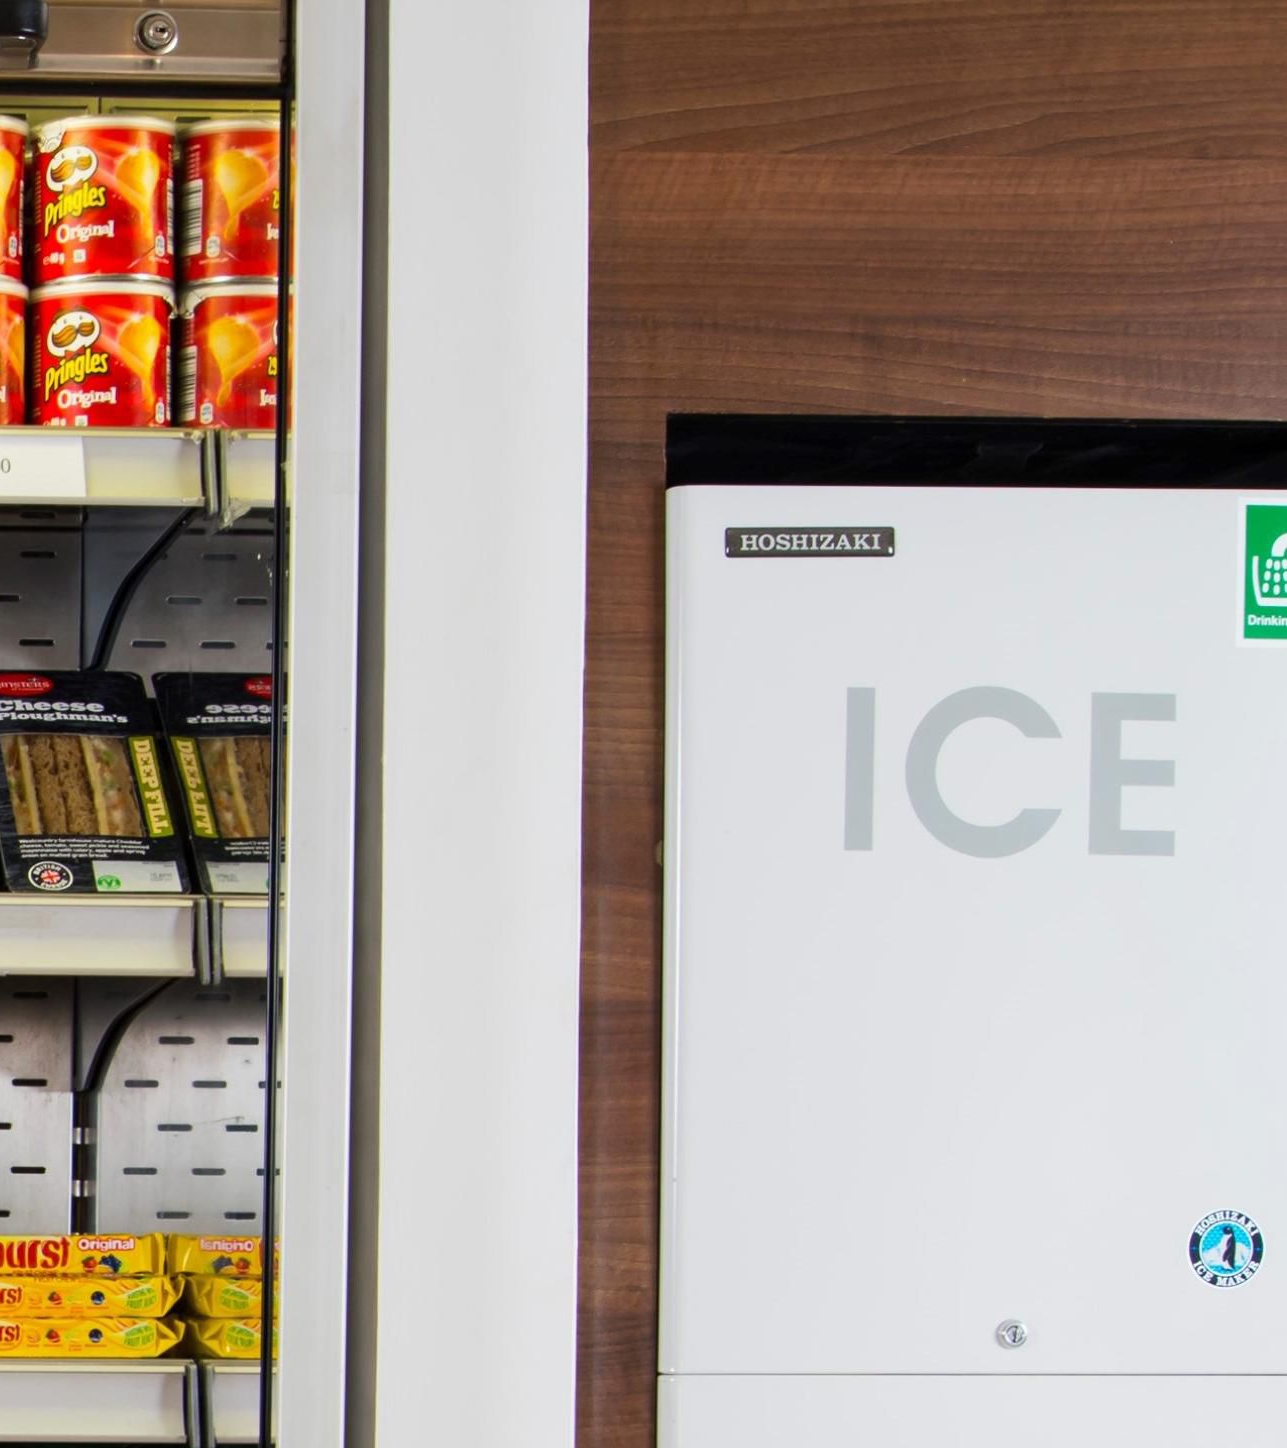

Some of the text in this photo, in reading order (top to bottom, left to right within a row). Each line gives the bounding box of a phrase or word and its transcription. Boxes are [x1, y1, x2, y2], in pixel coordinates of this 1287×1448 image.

[43, 181, 107, 236] Pringles
[56, 219, 115, 244] Original
[44, 347, 109, 402] Pringles
[57, 385, 117, 409] Original
[740, 533, 881, 551] HOSHIZAKI
[1247, 614, 1287, 626] Drinkin
[843, 685, 1177, 859] ICE
[133, 740, 169, 834] DEEP FILL
[1194, 1210, 1259, 1237] HOSHIZAKI
[77, 1237, 136, 1252] Original
[1193, 1261, 1259, 1286] ICE MAKER
